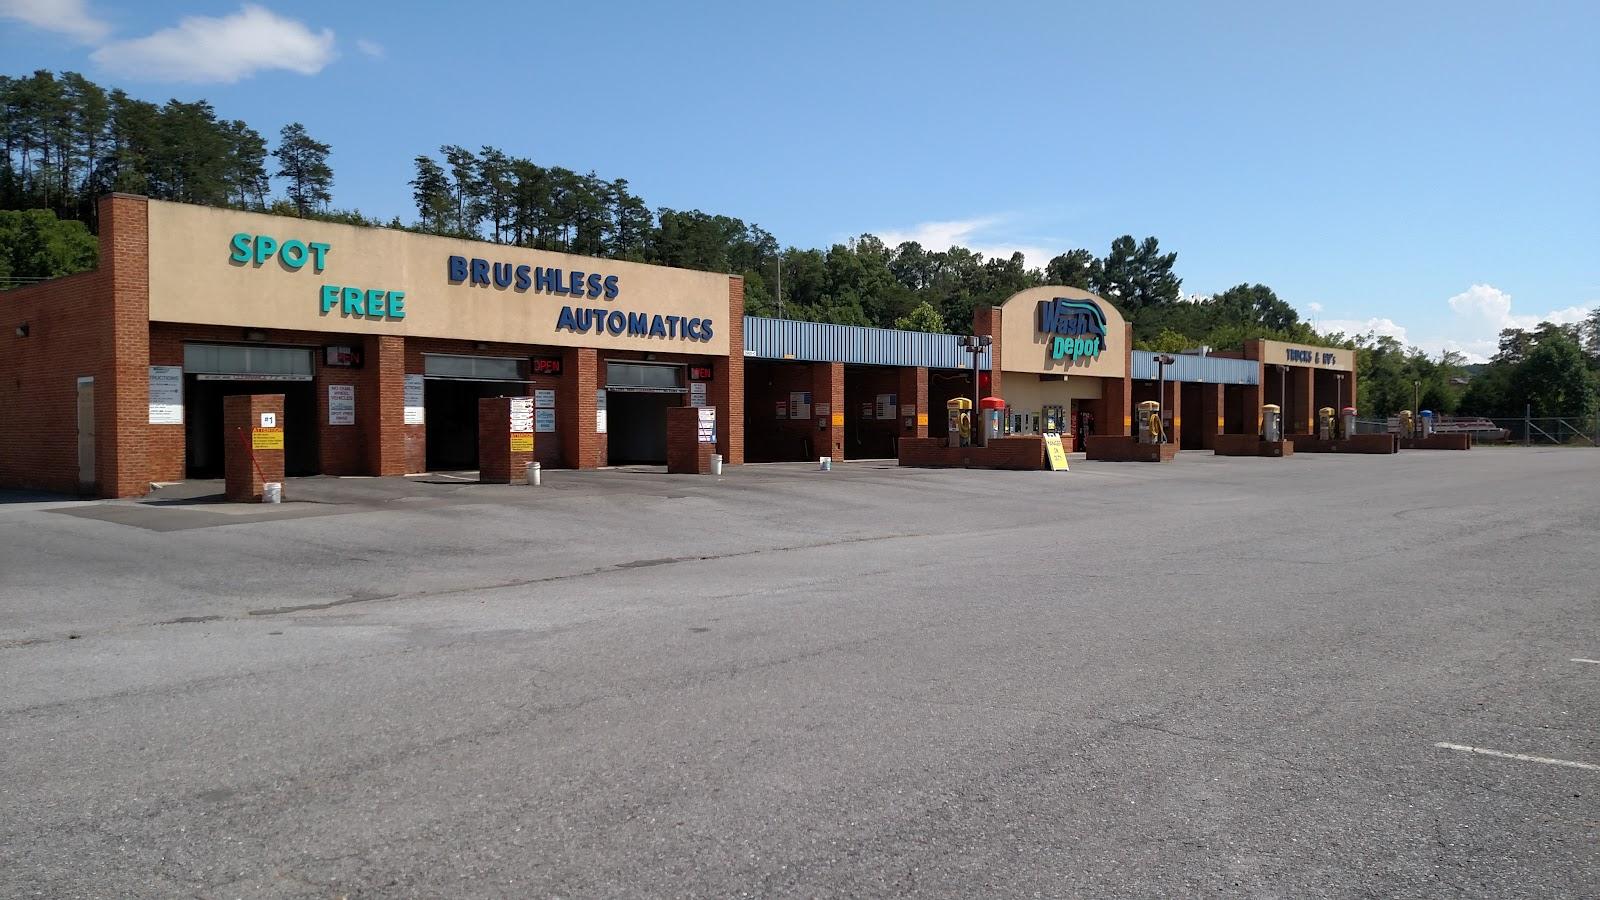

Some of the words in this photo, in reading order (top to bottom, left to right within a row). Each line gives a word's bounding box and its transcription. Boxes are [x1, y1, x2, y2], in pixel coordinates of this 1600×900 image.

[229, 232, 332, 271] SPOT
[447, 255, 620, 300] BRUSHLESS
[320, 284, 406, 319] FREE
[1038, 297, 1092, 336] Wash
[556, 306, 714, 342] AUTOMATICS
[534, 360, 560, 371] OPEN
[1052, 336, 1100, 361] Depot
[1286, 348, 1312, 364] TRUCKS
[264, 416, 273, 424] #1
